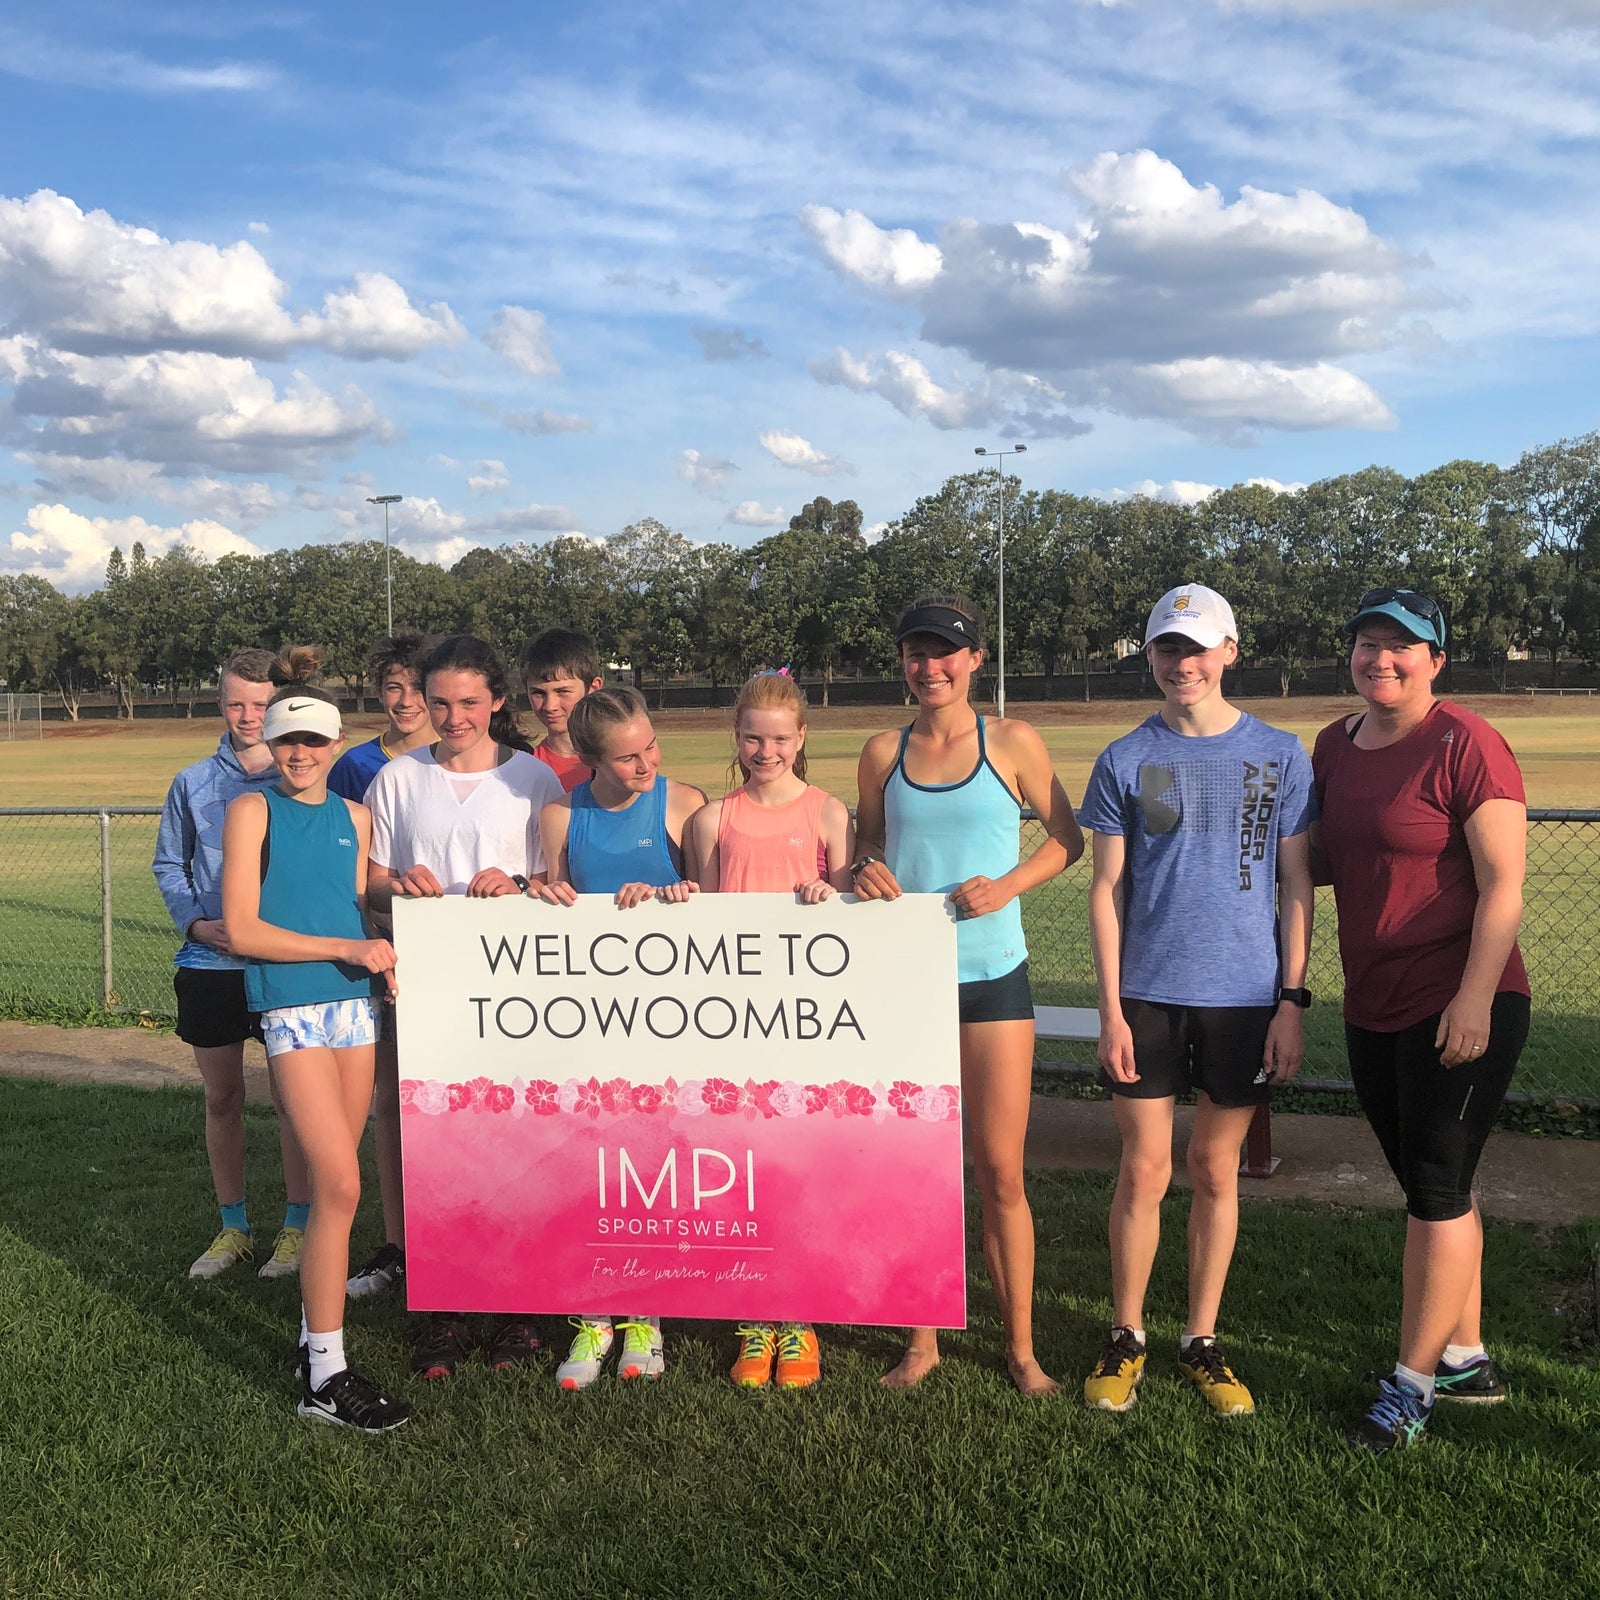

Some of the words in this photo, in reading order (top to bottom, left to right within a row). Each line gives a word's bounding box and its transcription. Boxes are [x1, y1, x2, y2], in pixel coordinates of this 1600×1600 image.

[1239, 760, 1260, 892] ARMOUR
[1252, 761, 1279, 862] UNDER
[480, 932, 762, 977] WELCOME
[778, 932, 850, 977] TO
[469, 995, 866, 1041] TOOWOOMBA
[598, 1146, 755, 1212] IMPI
[598, 1217, 758, 1238] SPORTSWEAR
[591, 1257, 618, 1279] For
[622, 1257, 650, 1279] the
[655, 1264, 711, 1281] warrior
[715, 1261, 768, 1282] within
